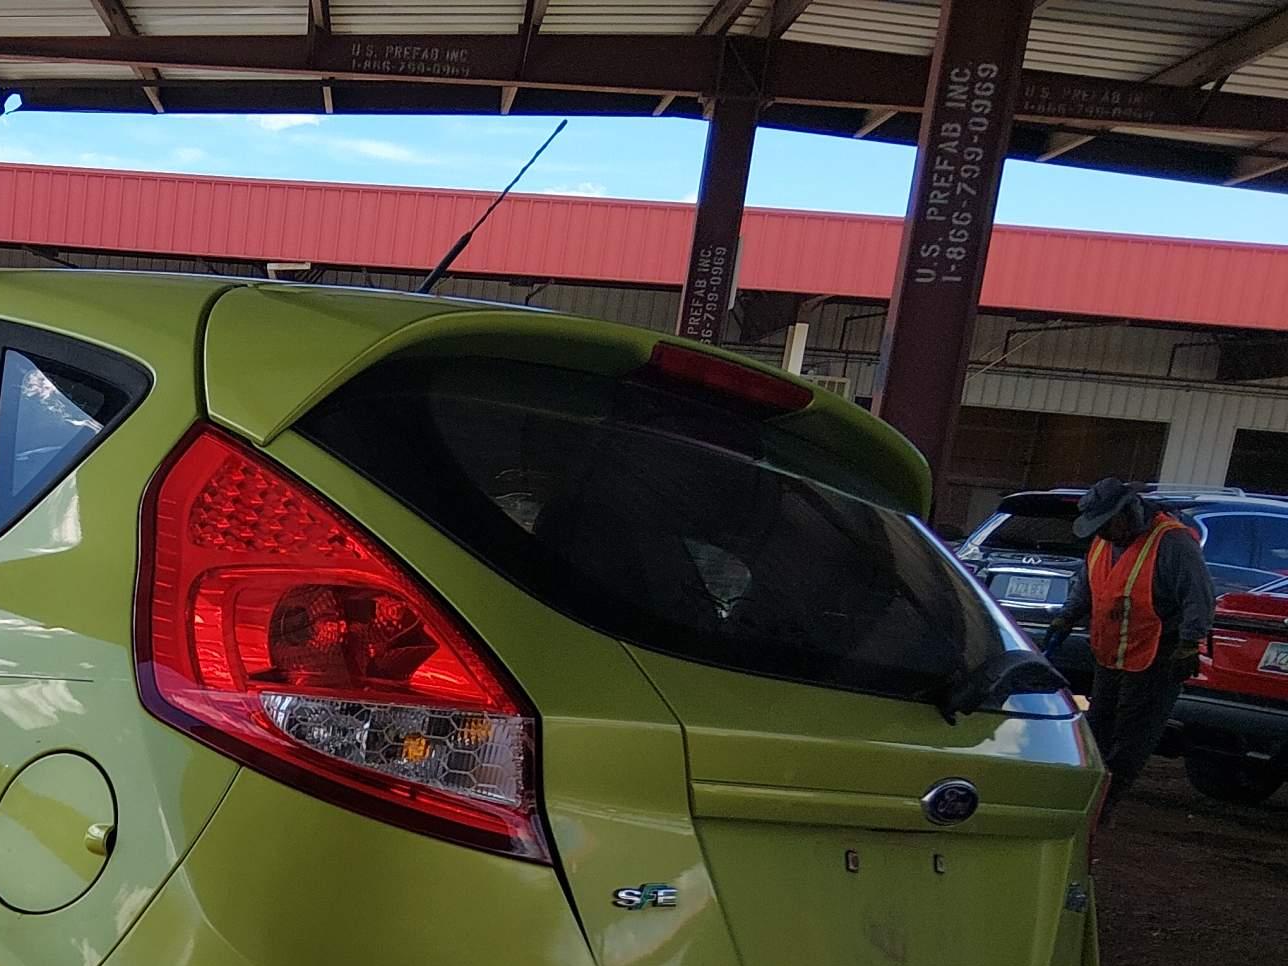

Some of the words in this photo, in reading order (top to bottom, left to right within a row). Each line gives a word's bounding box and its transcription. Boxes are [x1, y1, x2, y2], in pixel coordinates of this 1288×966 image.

[385, 45, 440, 61] PREFAB
[945, 61, 973, 108] INC.
[926, 122, 963, 221] PREFAB
[942, 63, 1000, 284] 1-866-799-0969
[697, 245, 713, 273] INC.
[915, 236, 943, 284] U.S.
[687, 279, 708, 335] PREFAB
